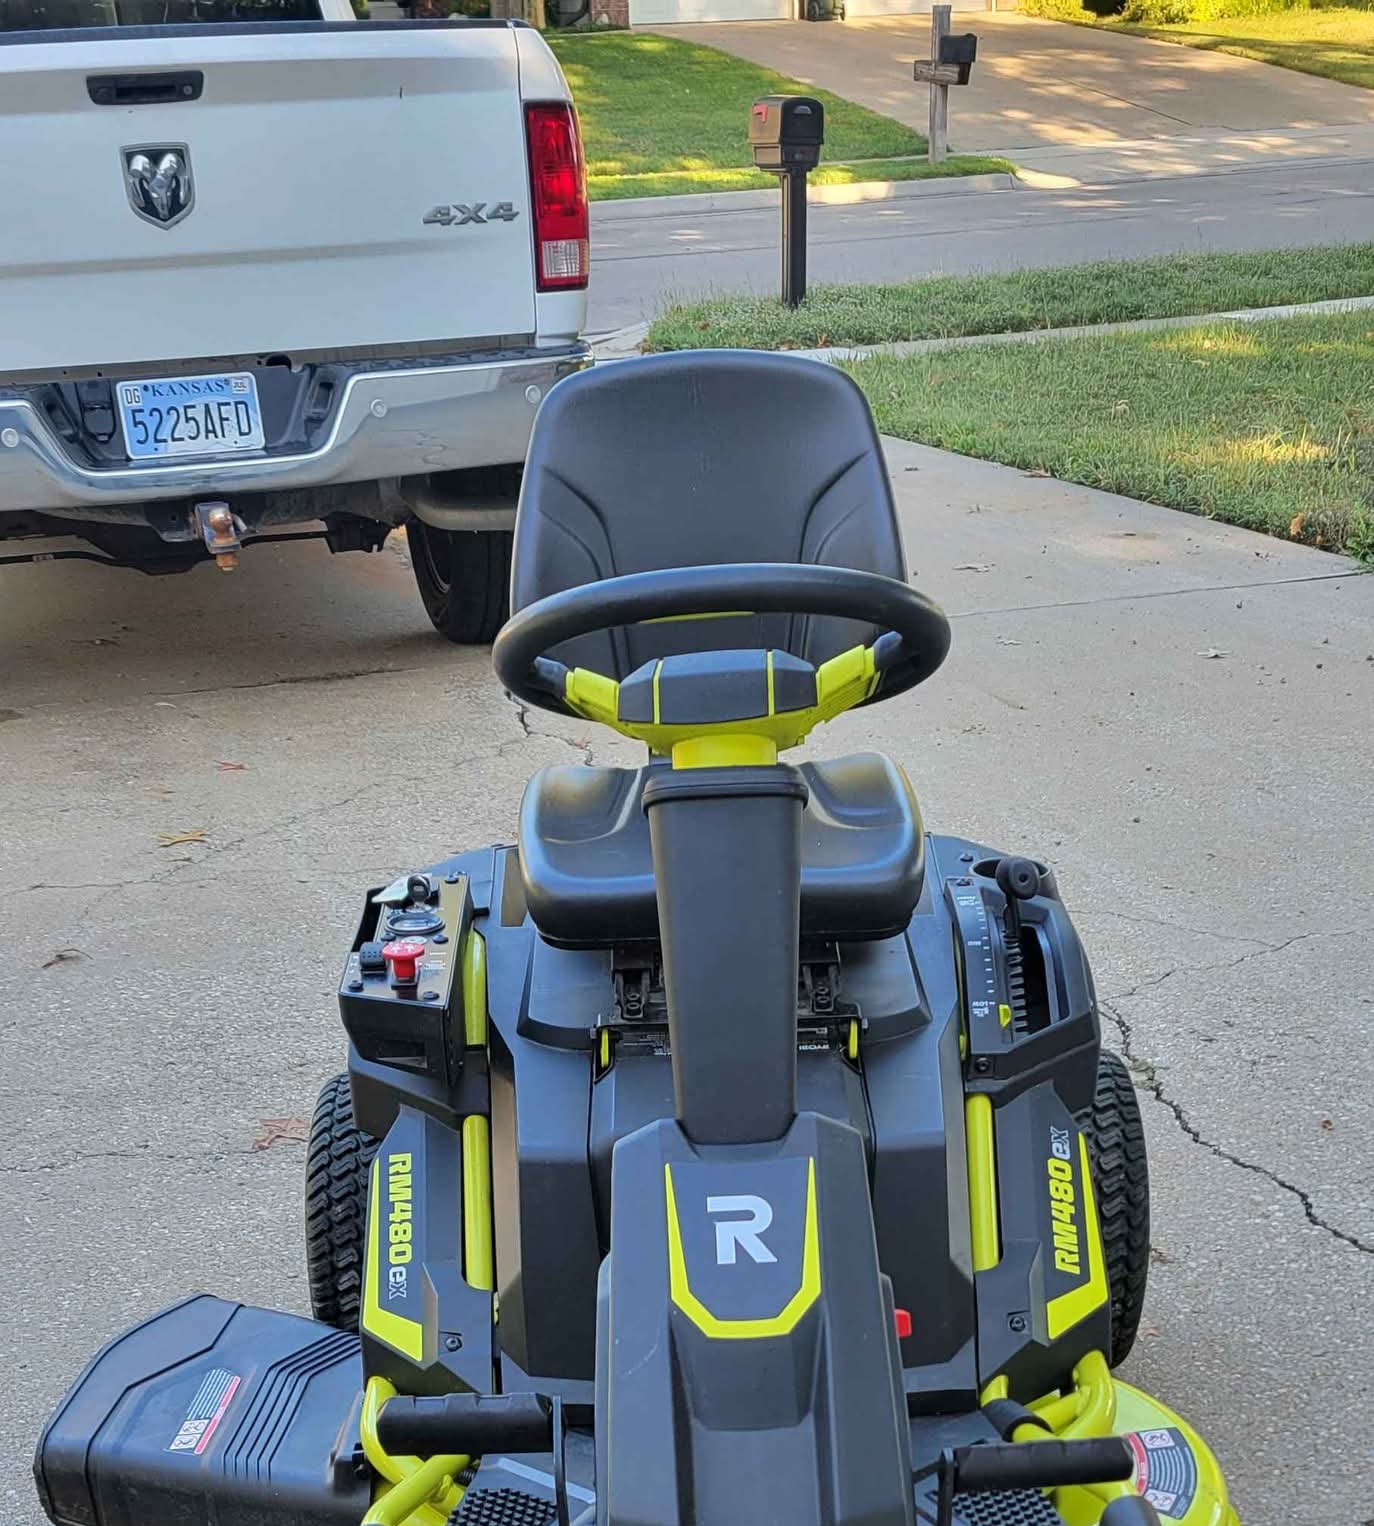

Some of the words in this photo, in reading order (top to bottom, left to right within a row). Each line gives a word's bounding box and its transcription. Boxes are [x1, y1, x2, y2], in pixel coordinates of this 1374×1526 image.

[422, 202, 520, 226] 4X4
[124, 387, 141, 404] DG
[150, 379, 225, 397] KANSAS
[130, 400, 252, 445] 5225AFD
[706, 1194, 778, 1264] R
